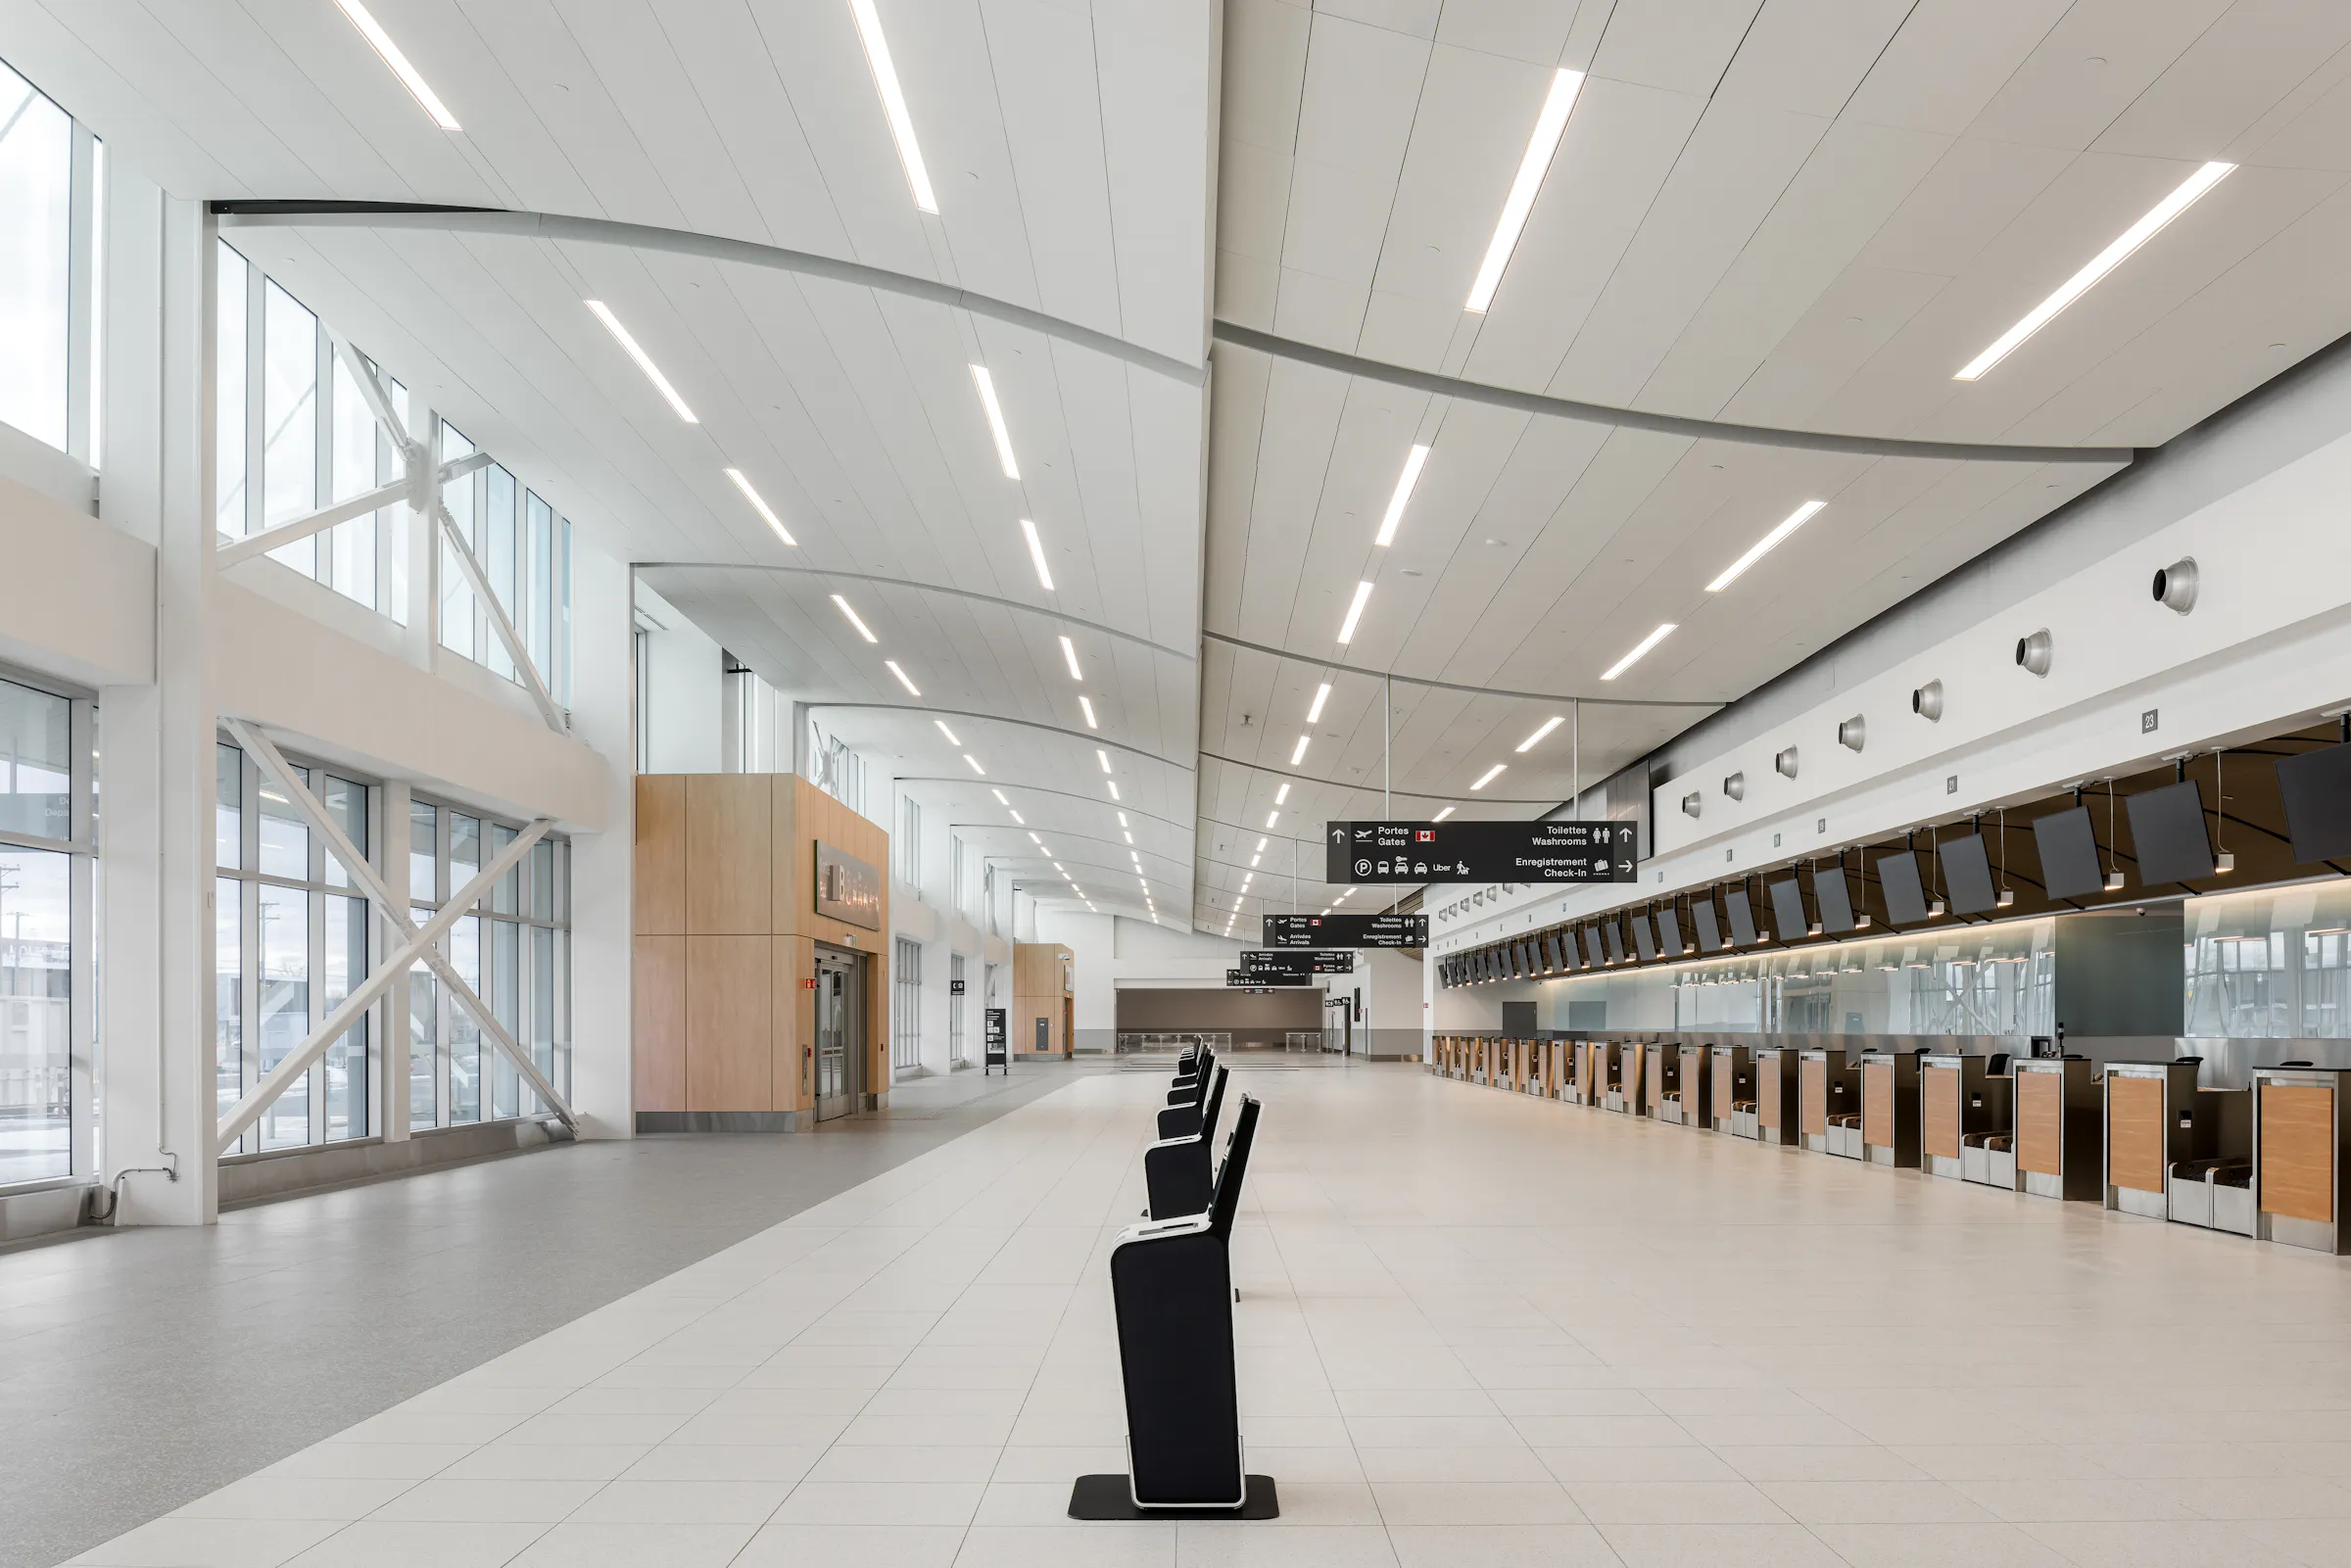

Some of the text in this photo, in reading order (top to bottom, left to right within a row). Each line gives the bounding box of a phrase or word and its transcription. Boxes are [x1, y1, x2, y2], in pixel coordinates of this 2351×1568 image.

[2145, 714, 2154, 729] 23
[1377, 826, 1410, 835] Portes
[1546, 826, 1588, 835] Toilettes
[1377, 836, 1407, 846] Gates
[1531, 836, 1588, 846] Washrooms
[1432, 863, 1452, 872] Uber
[1515, 857, 1588, 869] Enregistrement
[1544, 868, 1588, 878] Check-In
[831, 865, 844, 901] B
